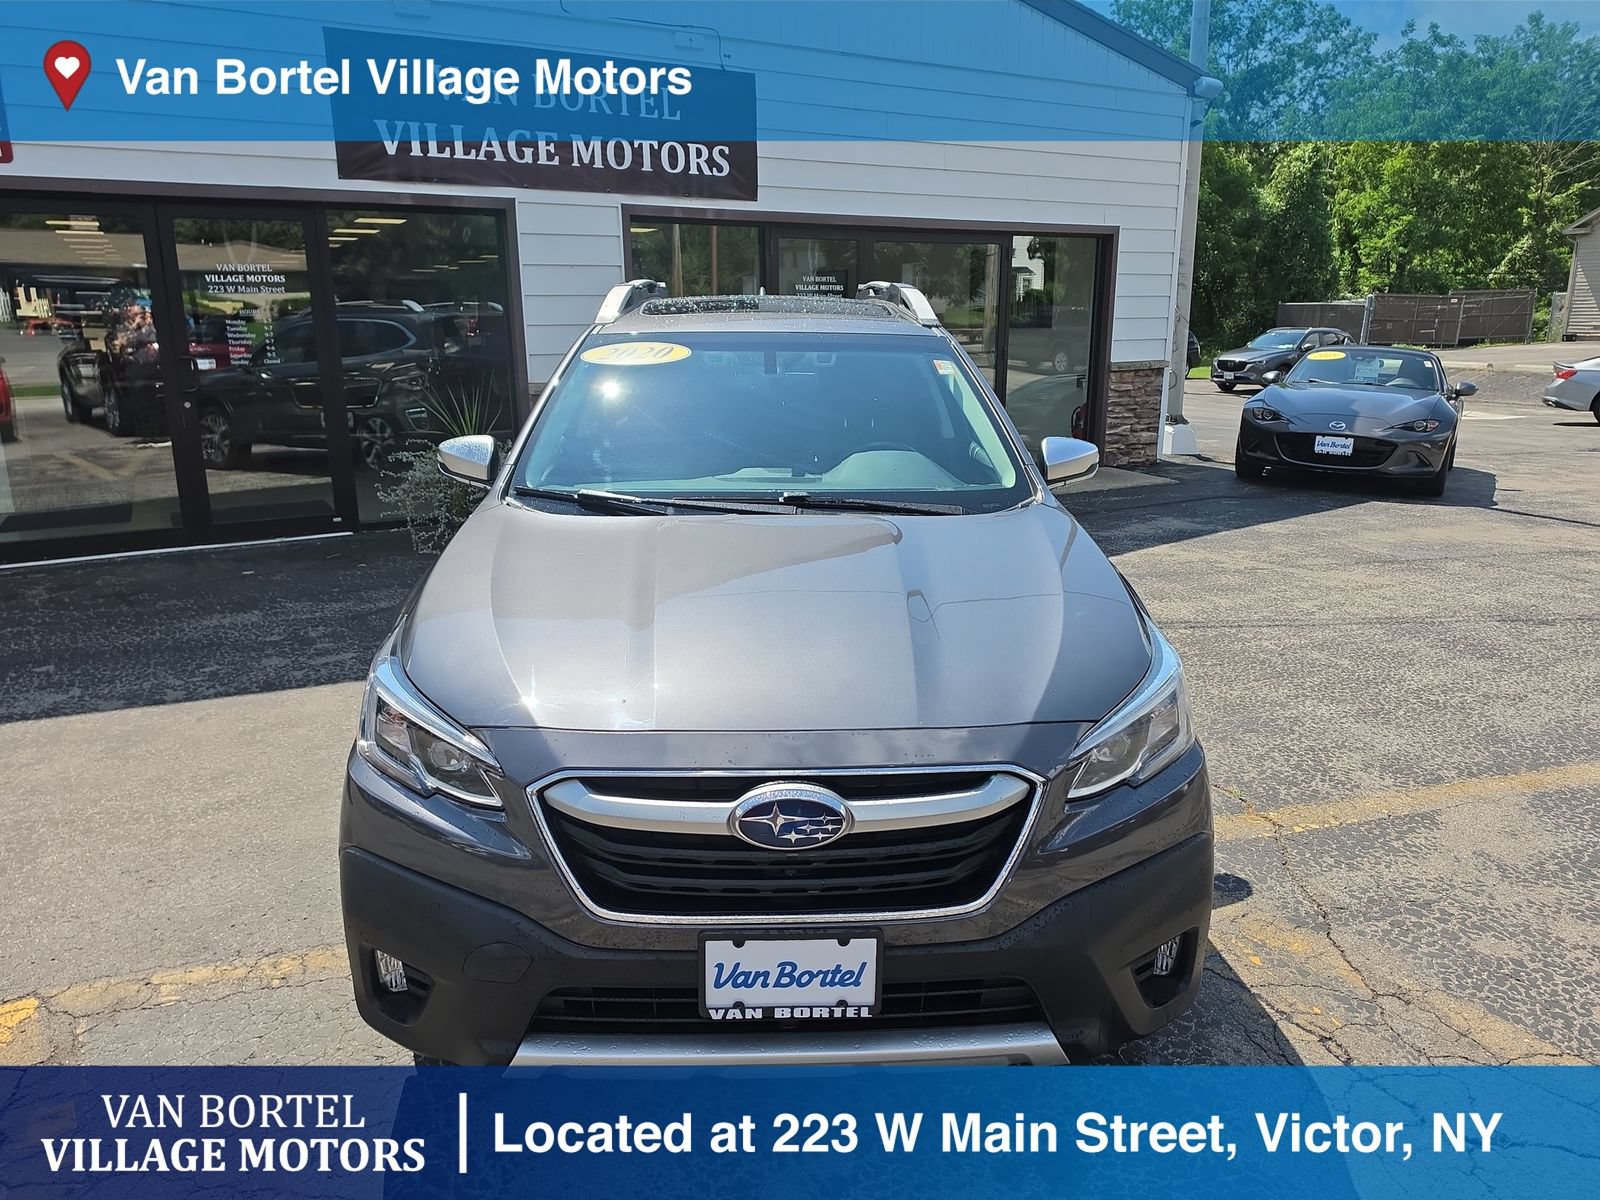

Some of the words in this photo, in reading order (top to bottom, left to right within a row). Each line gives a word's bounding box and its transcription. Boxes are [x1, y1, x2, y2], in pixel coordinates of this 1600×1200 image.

[532, 71, 682, 121] BORTEL
[373, 118, 560, 166] VILLAGE
[569, 133, 730, 177] MOTORS
[216, 263, 236, 272] VAN
[237, 263, 273, 272] BORTEL
[204, 274, 244, 283] VILLAGE
[246, 274, 286, 283] MOTORS
[208, 285, 224, 293] 223
[226, 285, 236, 293] W
[237, 285, 259, 294] Main
[260, 285, 286, 294] Street
[597, 346, 675, 360] 2020
[1330, 441, 1352, 449] Bortel
[714, 962, 770, 989] Van
[772, 961, 867, 988] Bortel
[708, 1009, 763, 1020] VAN
[774, 1007, 872, 1019] BORTEL
